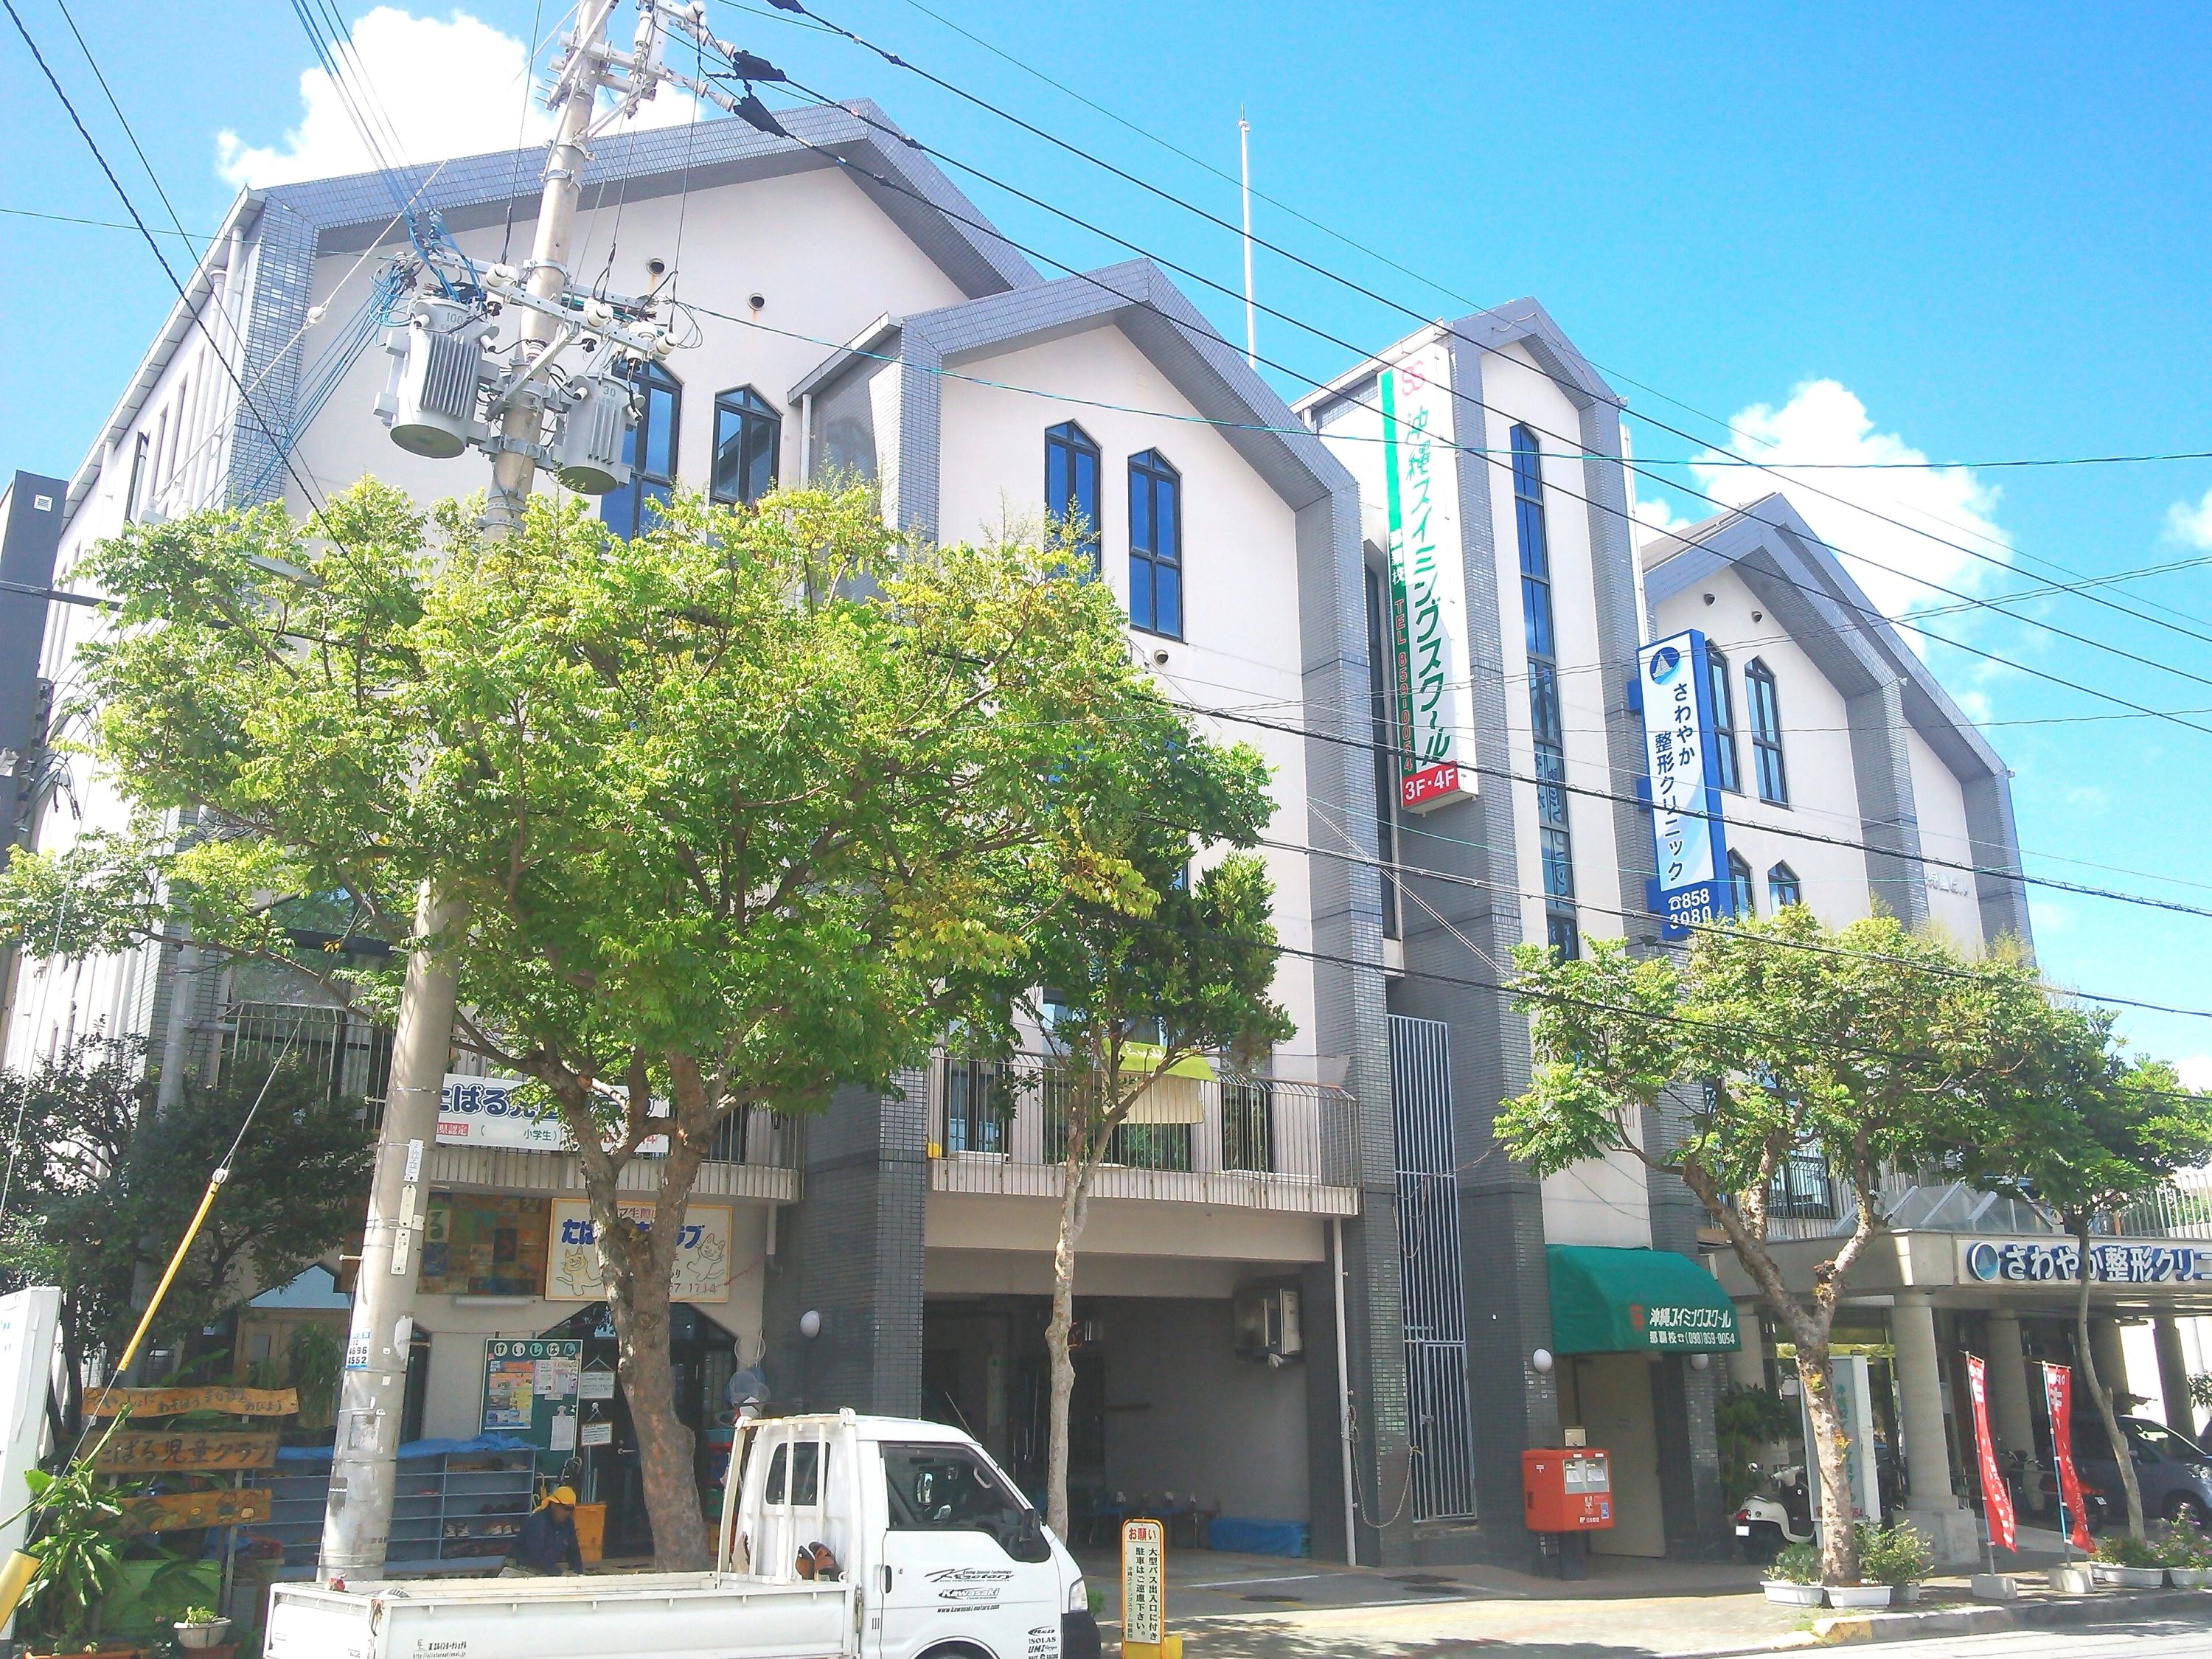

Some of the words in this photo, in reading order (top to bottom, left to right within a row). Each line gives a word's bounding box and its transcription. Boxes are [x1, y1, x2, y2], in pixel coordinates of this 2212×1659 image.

[603, 386, 616, 397] 30
[1394, 599, 1407, 645] TEL
[1674, 682, 1695, 767] さわやか
[1655, 731, 1683, 883] 整形クリニック
[1681, 888, 1710, 908] 858
[1649, 1307, 1732, 1328] 沖縄スイミングスクール
[1128, 1528, 1157, 1540] お願い
[942, 1587, 1001, 1597] Kawasaki
[1135, 1547, 1145, 1636] 駐車はご遠慮下さい。
[1148, 1548, 1158, 1641] 大型バス出入口に付き
[1028, 1645, 1045, 1653] UMI
